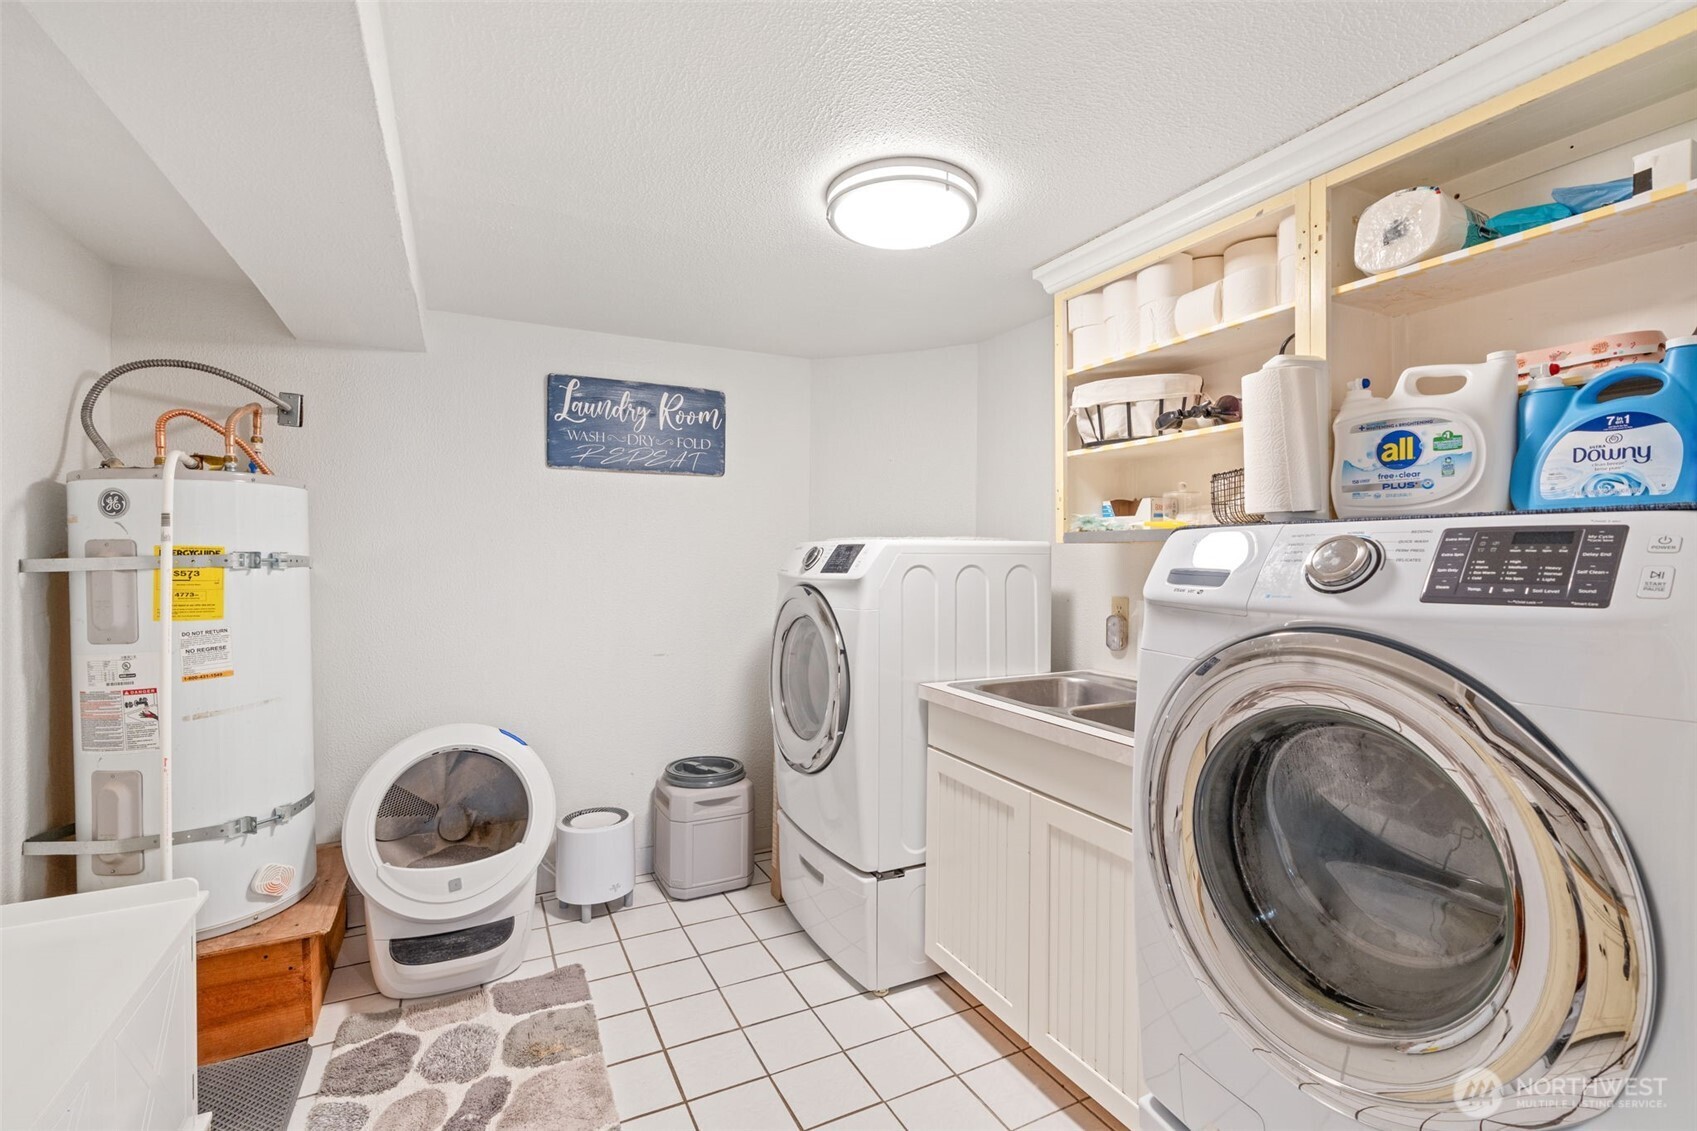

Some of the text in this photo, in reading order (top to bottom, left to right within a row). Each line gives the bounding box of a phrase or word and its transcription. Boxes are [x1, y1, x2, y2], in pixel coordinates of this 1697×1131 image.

[554, 379, 723, 432] Laundry Room
[1398, 419, 1434, 428] BRIGHTENING
[1606, 416, 1615, 426] 7
[1624, 414, 1630, 424] 1
[567, 430, 711, 450] WASH DRY FOLD
[1380, 436, 1415, 462] all
[1573, 445, 1652, 464] Downy
[570, 444, 707, 470] REPEAT
[1398, 471, 1421, 479] clear
[1382, 481, 1416, 490] PLUS
[196, 645, 227, 653] REGRESE
